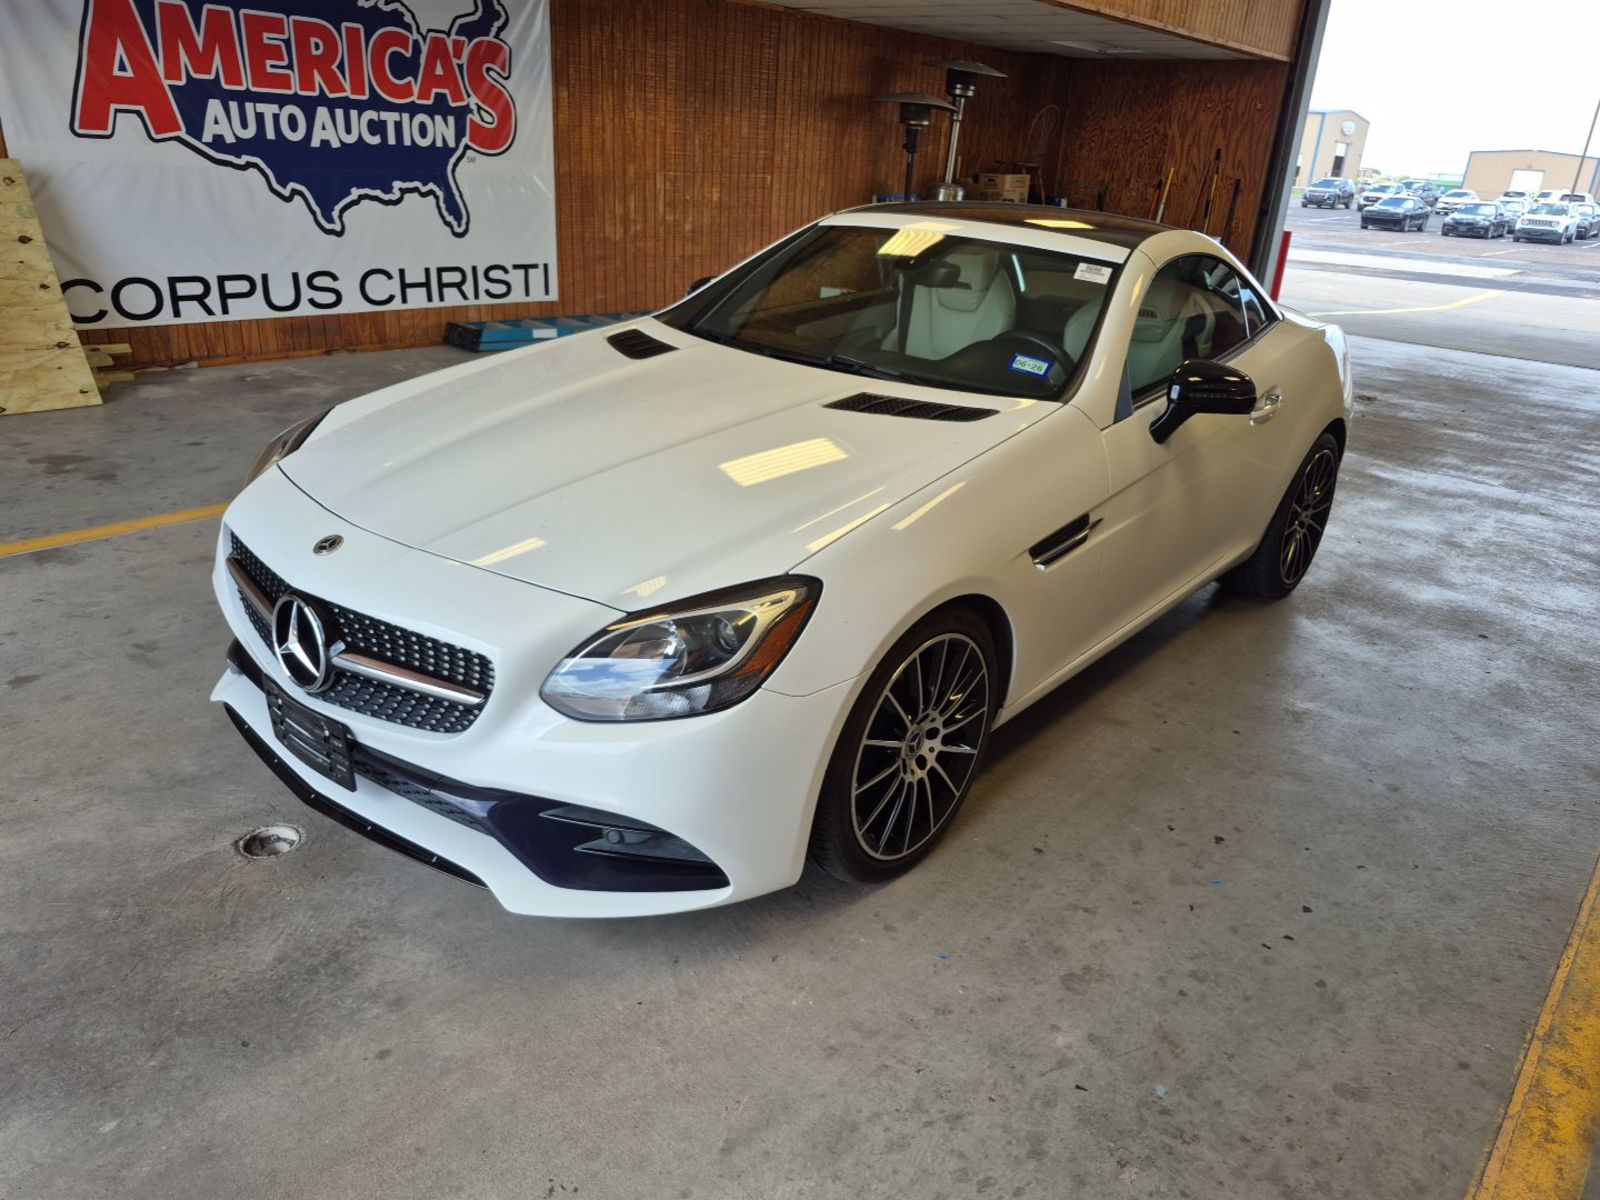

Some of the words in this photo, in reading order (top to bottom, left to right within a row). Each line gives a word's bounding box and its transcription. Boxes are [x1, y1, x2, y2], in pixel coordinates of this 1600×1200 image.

[74, 0, 515, 154] AMERICA'S
[201, 98, 307, 144] AUTO
[310, 106, 456, 148] AUCTION
[60, 270, 343, 324] CORPUS
[359, 262, 549, 306] CHRISTI
